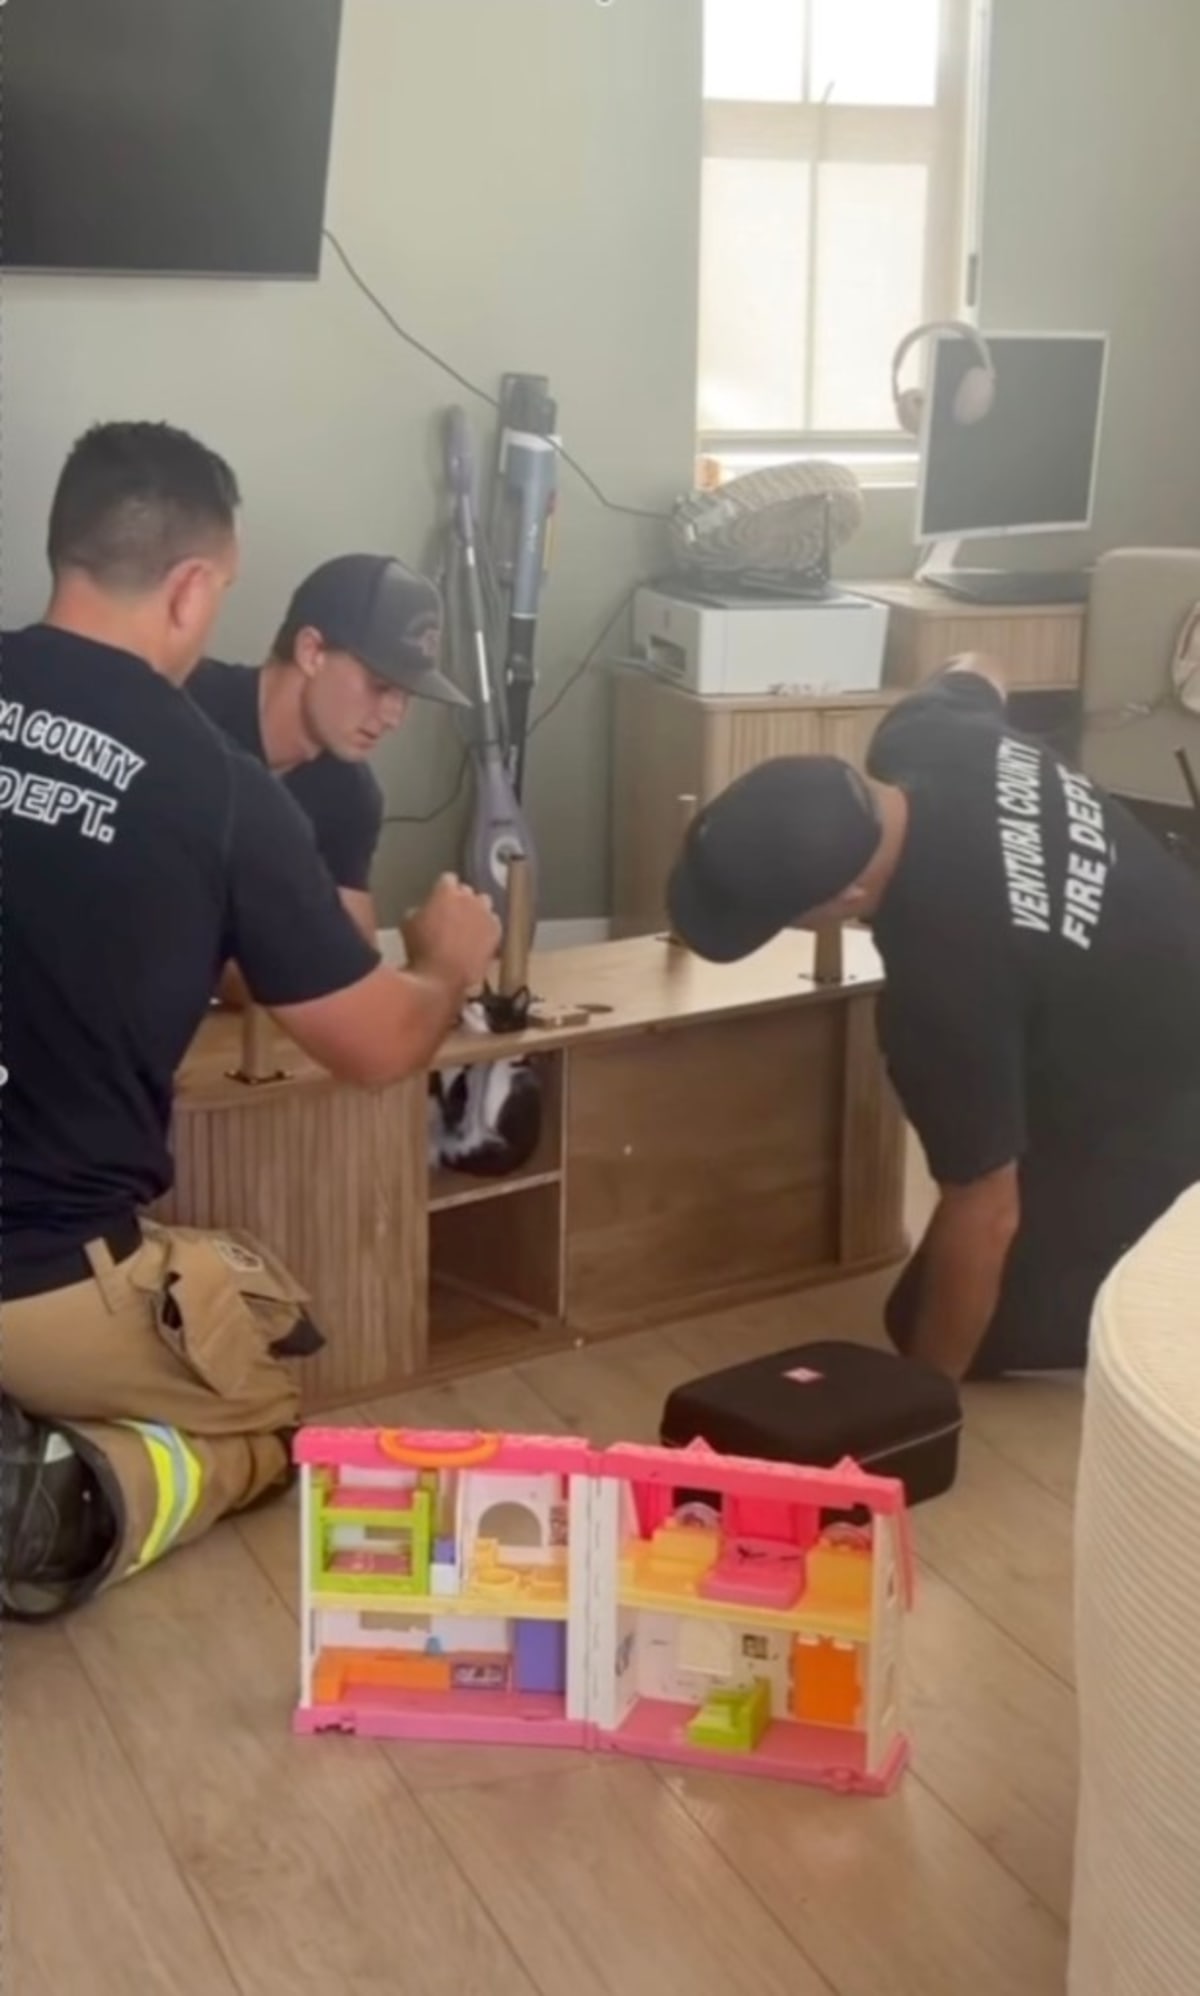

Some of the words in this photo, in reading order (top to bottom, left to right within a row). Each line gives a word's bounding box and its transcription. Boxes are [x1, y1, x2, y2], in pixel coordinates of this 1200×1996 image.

[21, 710, 146, 791] COUNTY
[998, 817, 1050, 932] VENTURA
[1061, 852, 1108, 950] FIRE
